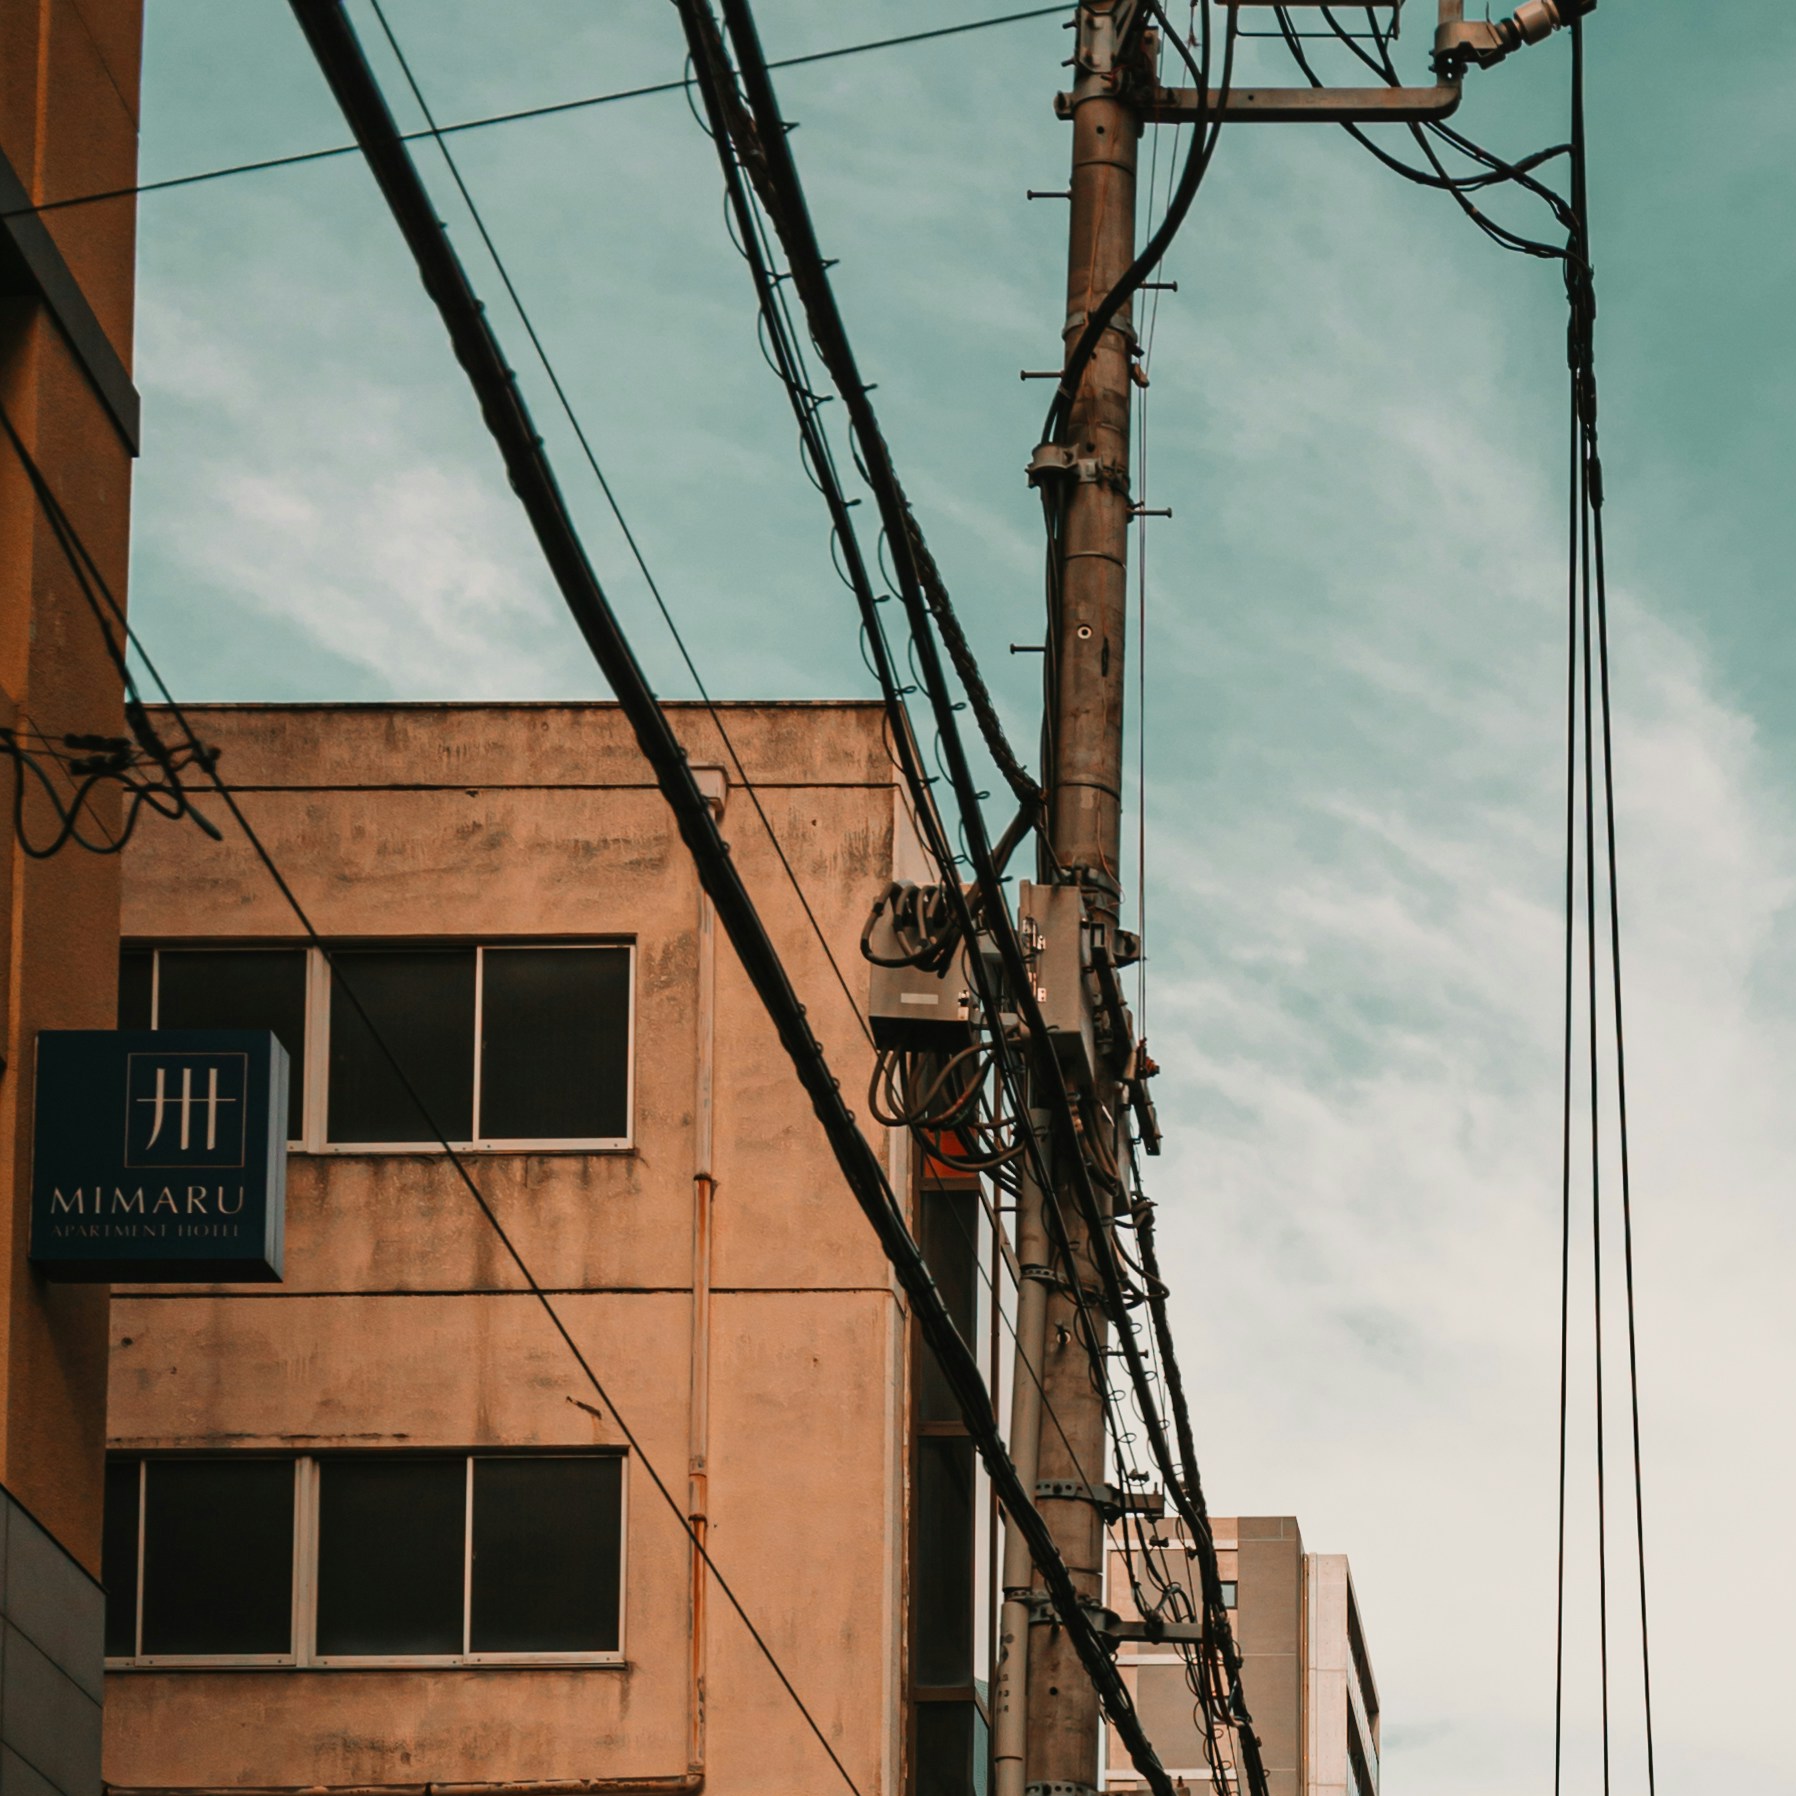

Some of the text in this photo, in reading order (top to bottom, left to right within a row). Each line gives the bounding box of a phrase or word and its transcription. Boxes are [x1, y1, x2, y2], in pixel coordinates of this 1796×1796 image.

[50, 1186, 244, 1215] MIMARU
[52, 1224, 240, 1237] APARTMENT HOTEL
